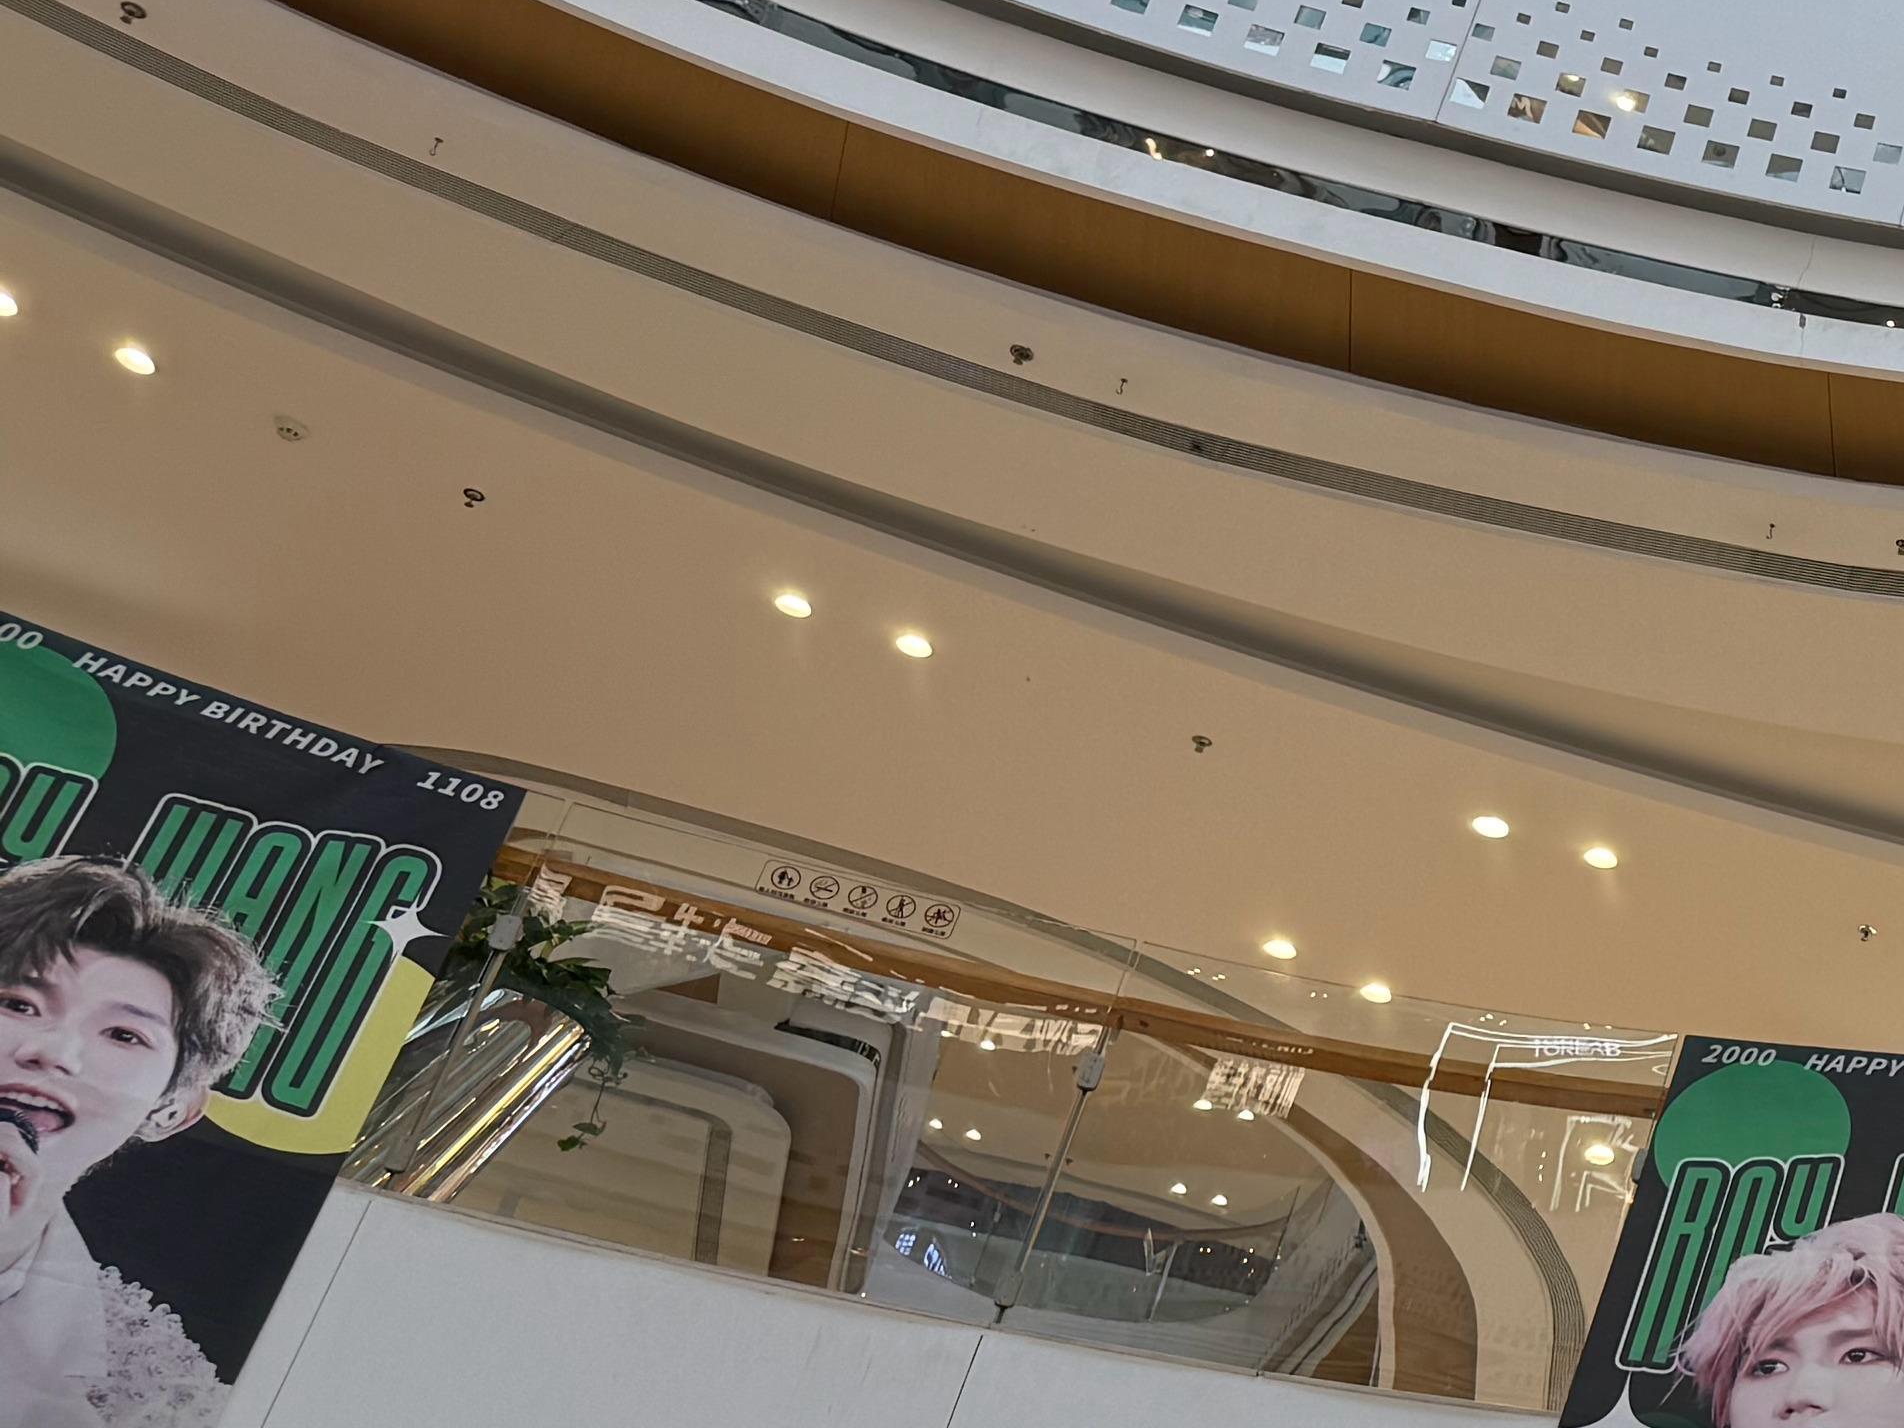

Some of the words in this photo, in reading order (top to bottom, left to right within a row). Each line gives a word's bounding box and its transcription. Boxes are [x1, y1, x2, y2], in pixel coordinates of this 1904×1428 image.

[72, 652, 200, 707] HAPPY
[200, 701, 385, 775] BIRTHDAY
[416, 772, 505, 812] 1108
[1701, 1044, 1777, 1068] 2000
